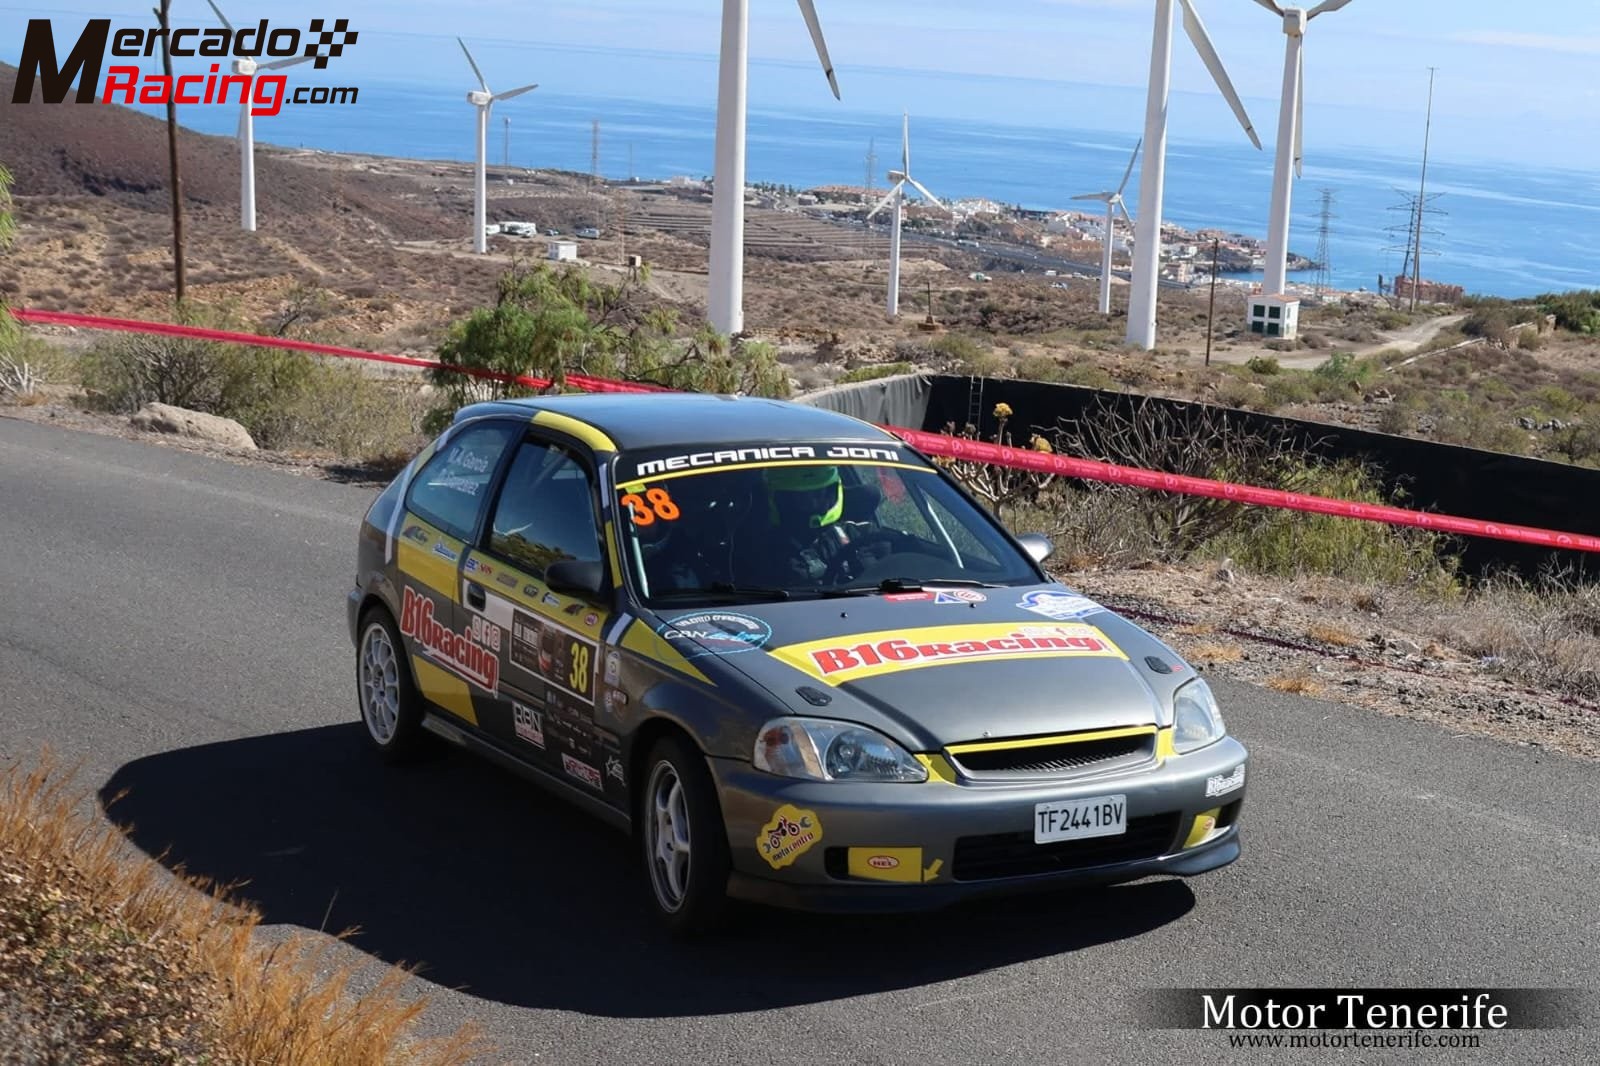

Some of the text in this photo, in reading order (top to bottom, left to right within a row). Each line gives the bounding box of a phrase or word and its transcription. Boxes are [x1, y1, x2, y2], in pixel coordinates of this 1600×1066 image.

[636, 446, 815, 476] MECANICA
[826, 446, 899, 462] JONI
[621, 487, 681, 526] 38
[569, 641, 589, 693] 38
[811, 633, 1103, 674] B16Racing
[1037, 802, 1123, 833] TF2441BV
